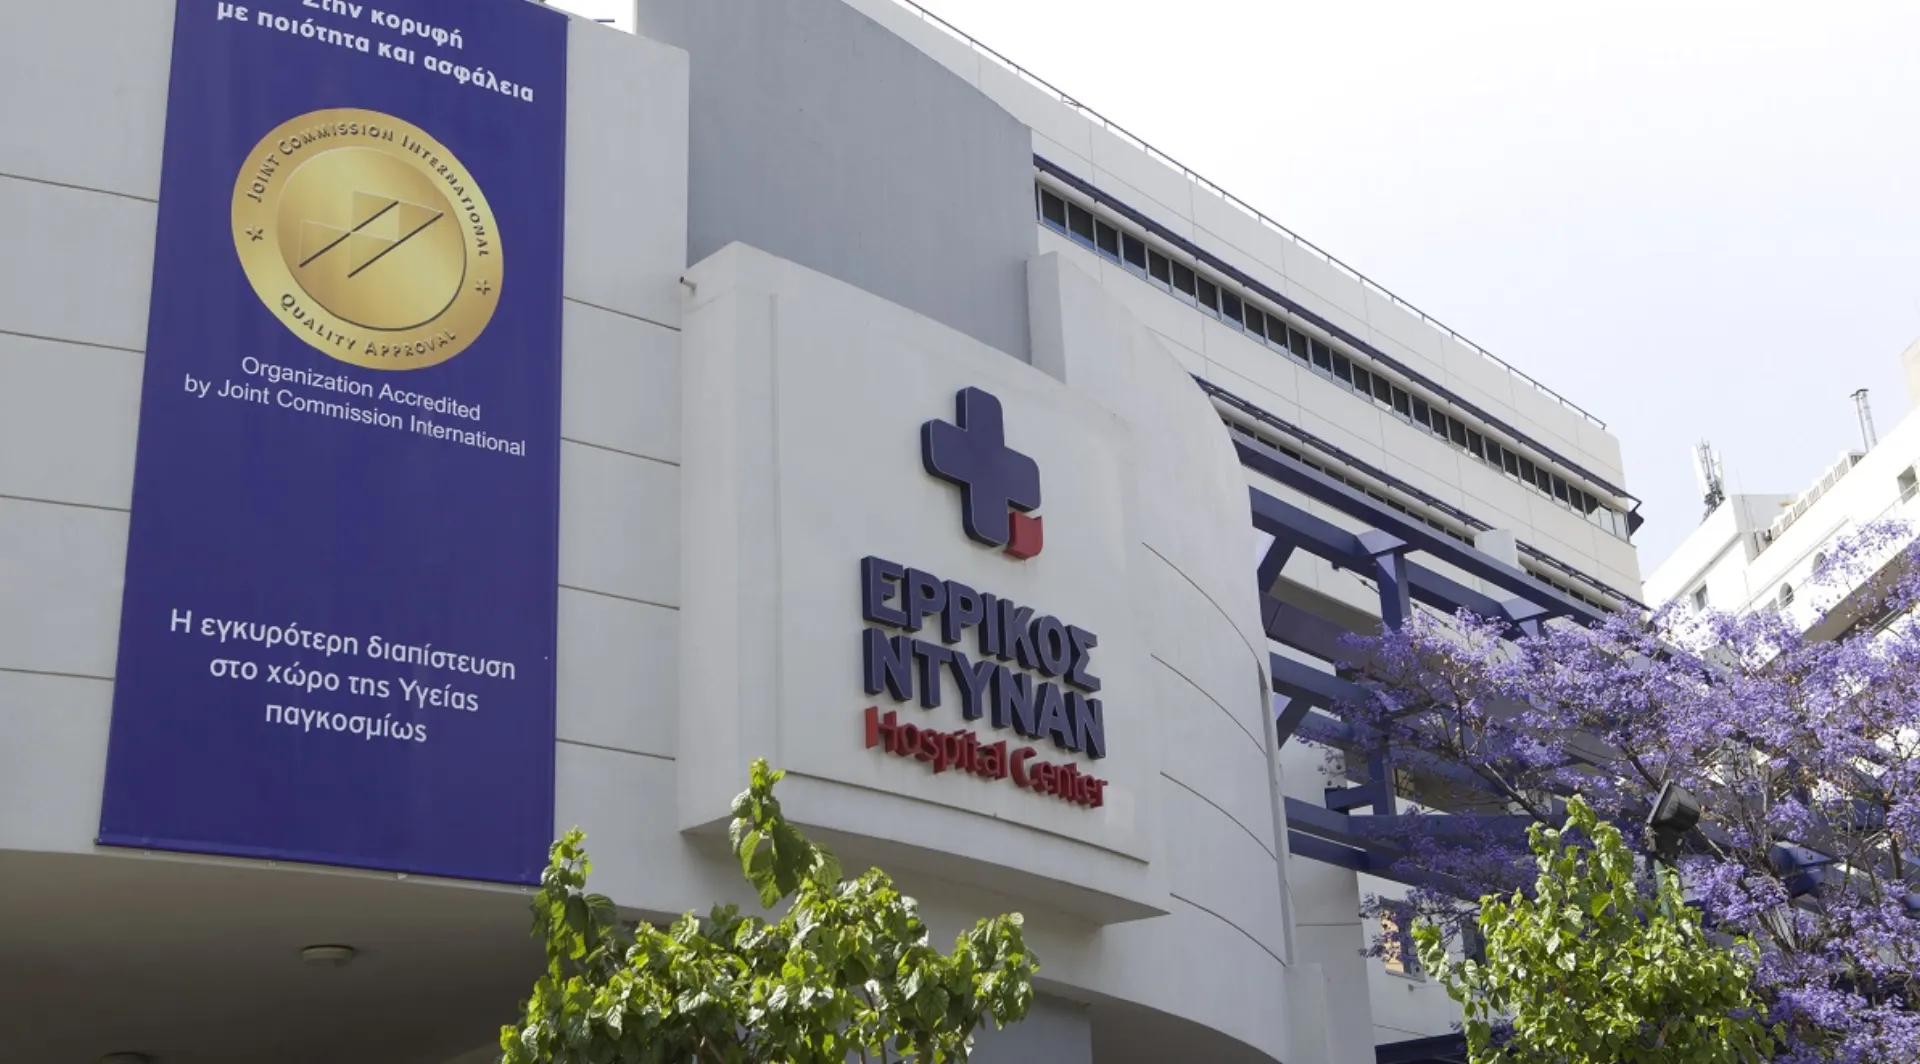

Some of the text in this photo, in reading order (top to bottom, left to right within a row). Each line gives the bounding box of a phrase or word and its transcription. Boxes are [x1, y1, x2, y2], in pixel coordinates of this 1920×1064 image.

[216, 2, 534, 102] με ποιότητα και ασφάλεια
[371, 9, 463, 49] κορυφή
[184, 374, 526, 456] by Joint Commission International
[241, 356, 481, 421] Organization Accredited
[170, 609, 516, 680] Η εγκυρότερη διαπίστευση
[861, 555, 1101, 692] ΕΡΡΙΚΟΣ
[210, 658, 480, 712] στο χώρο της Υγείας
[265, 703, 428, 742] παγκοσμίως
[863, 627, 1106, 760] ΝΤΥΝΑΝ
[864, 706, 1109, 808] Hospital Center
